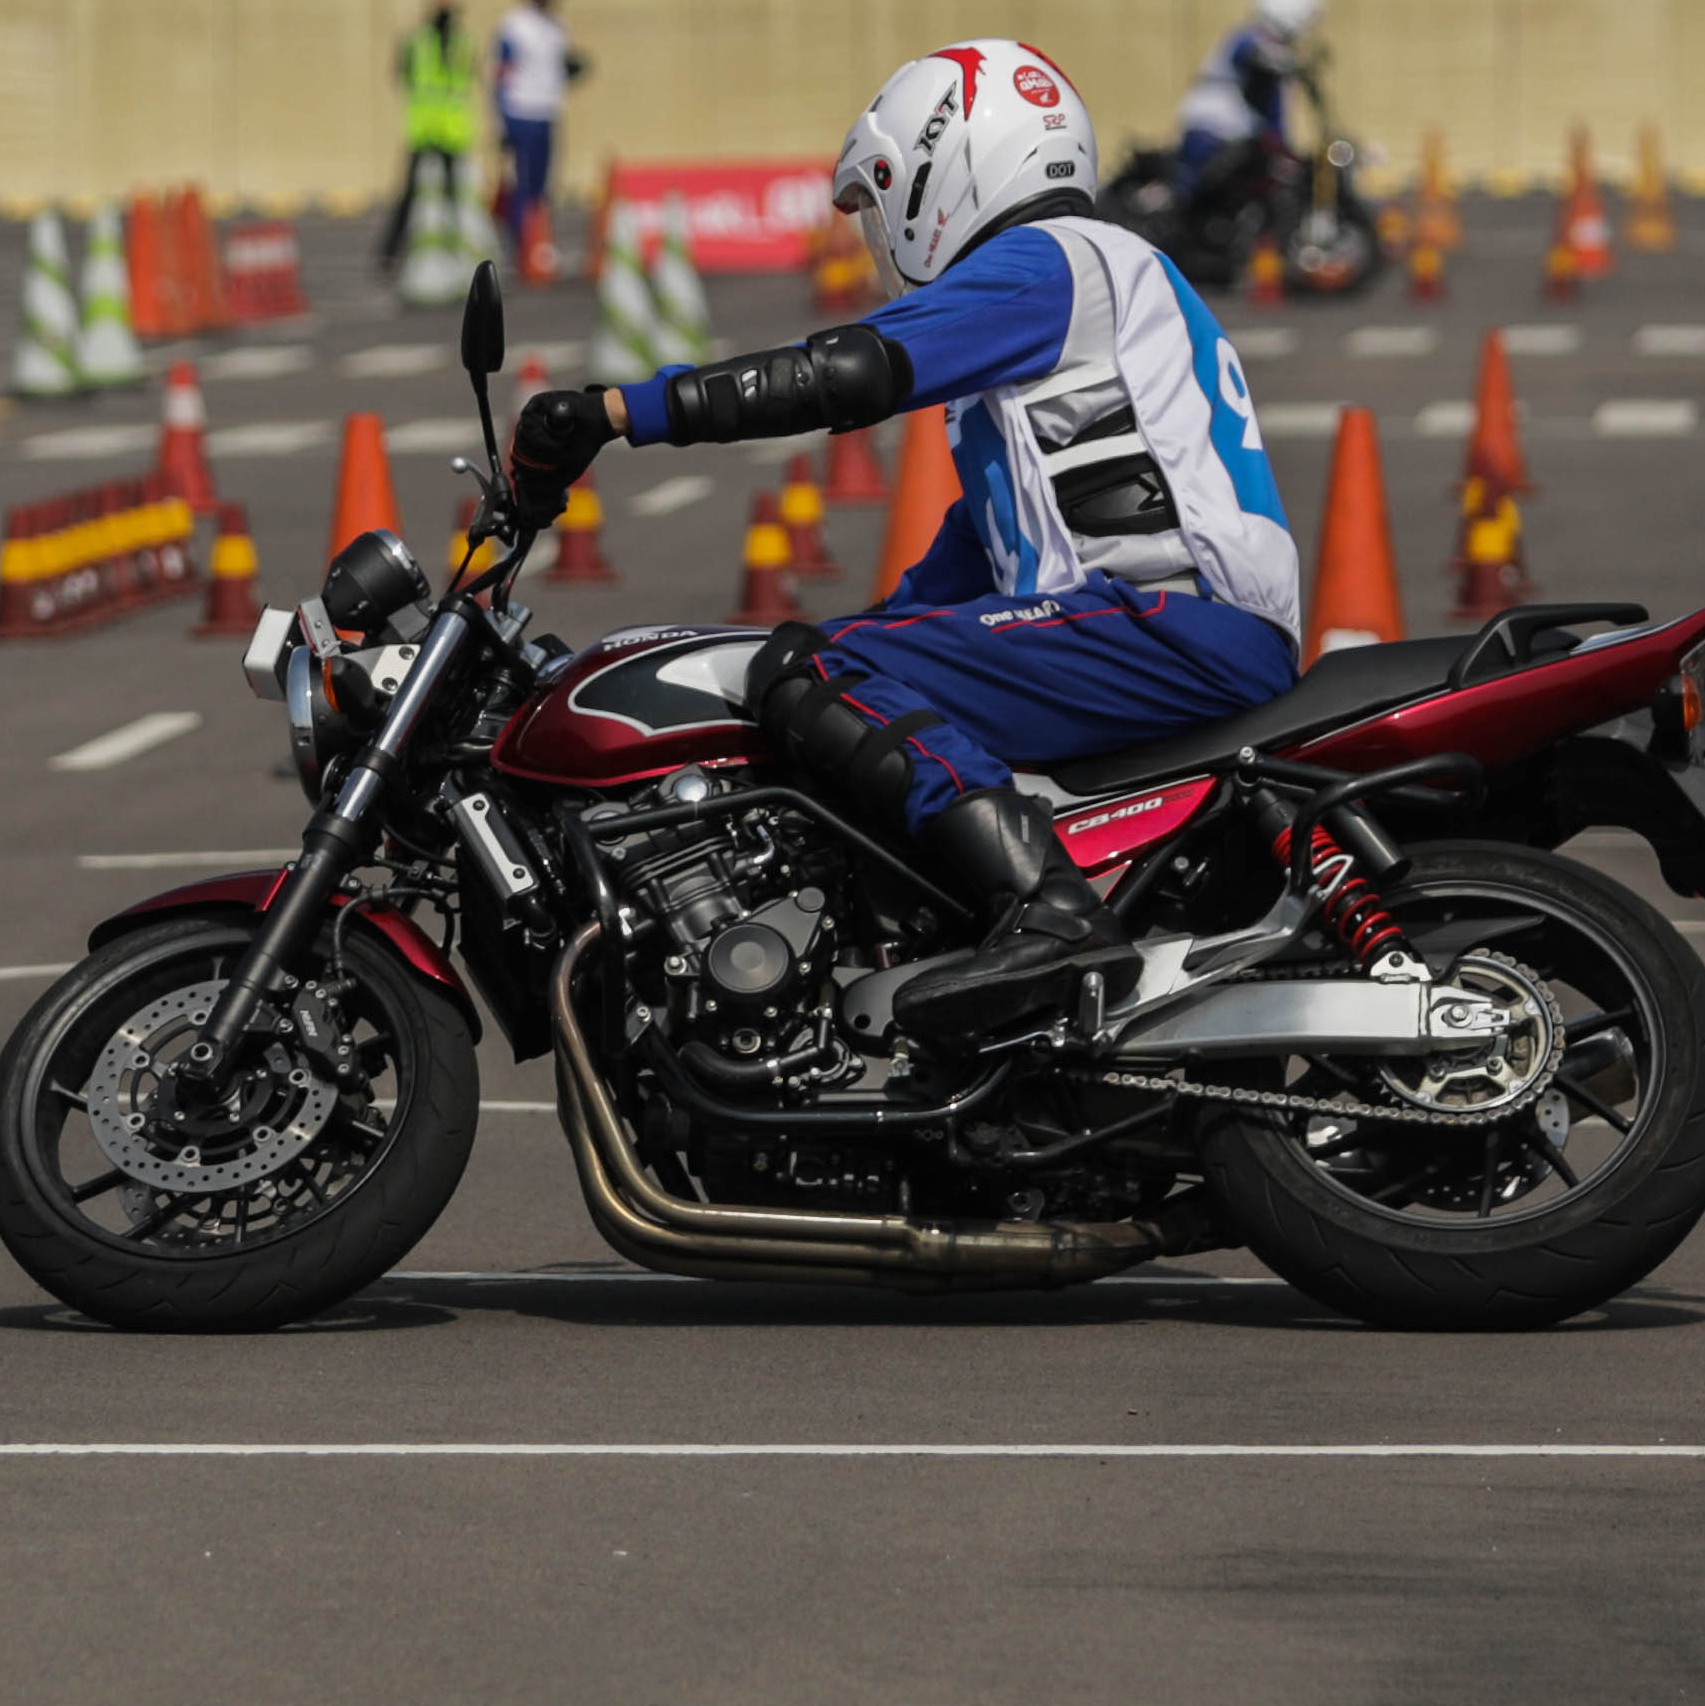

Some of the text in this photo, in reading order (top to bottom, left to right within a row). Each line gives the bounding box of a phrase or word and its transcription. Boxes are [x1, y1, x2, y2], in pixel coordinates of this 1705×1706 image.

[913, 80, 959, 157] KYT
[1049, 163, 1071, 177] DOT
[979, 610, 1014, 627] One
[602, 630, 699, 652] HONDA
[1067, 796, 1164, 835] CB400
